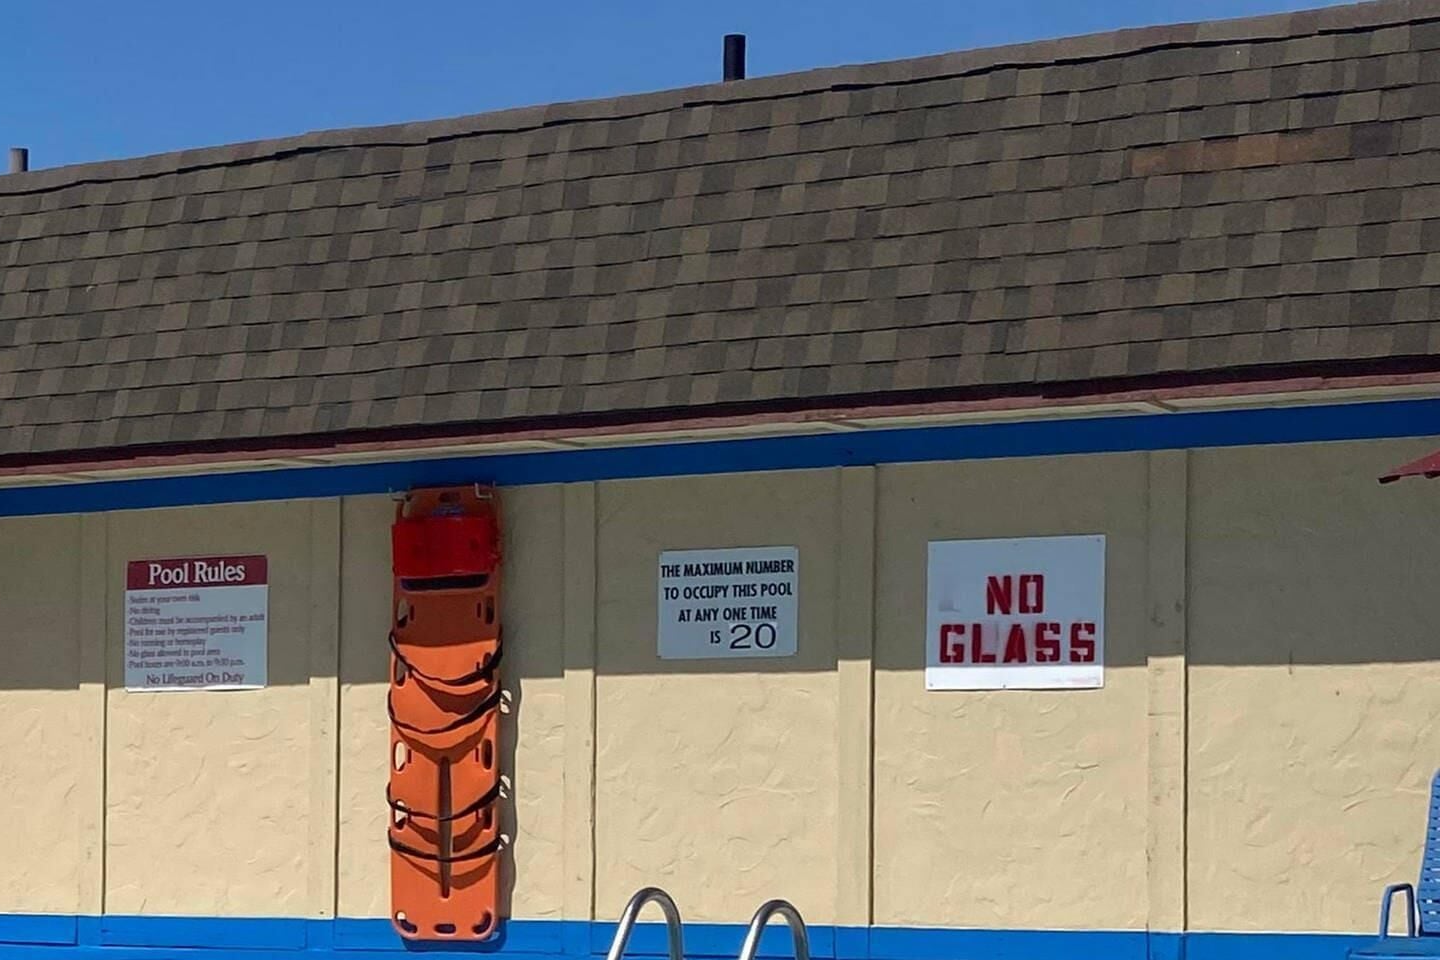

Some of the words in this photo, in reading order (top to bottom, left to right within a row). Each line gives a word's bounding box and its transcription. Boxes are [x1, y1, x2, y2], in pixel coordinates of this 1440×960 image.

[149, 563, 189, 585] Pool
[193, 561, 245, 583] Rules
[661, 565, 680, 578] THE
[683, 561, 742, 577] MAXIMUM
[745, 559, 794, 575] NUMBER
[664, 587, 679, 600] TO
[683, 585, 729, 599] OCCUPY
[732, 584, 757, 598] THIS
[760, 582, 792, 597] POOL
[987, 574, 1044, 615] NO
[678, 609, 691, 622] AT
[695, 608, 719, 622] ANY
[723, 607, 746, 621] ONE
[750, 606, 777, 620] TIME
[710, 630, 721, 644] IS
[729, 623, 777, 649] 20
[940, 622, 1095, 663] GLASS
[146, 673, 160, 685] No
[162, 672, 204, 685] Lifeguard
[205, 671, 220, 683] On
[222, 671, 244, 685] Duty
